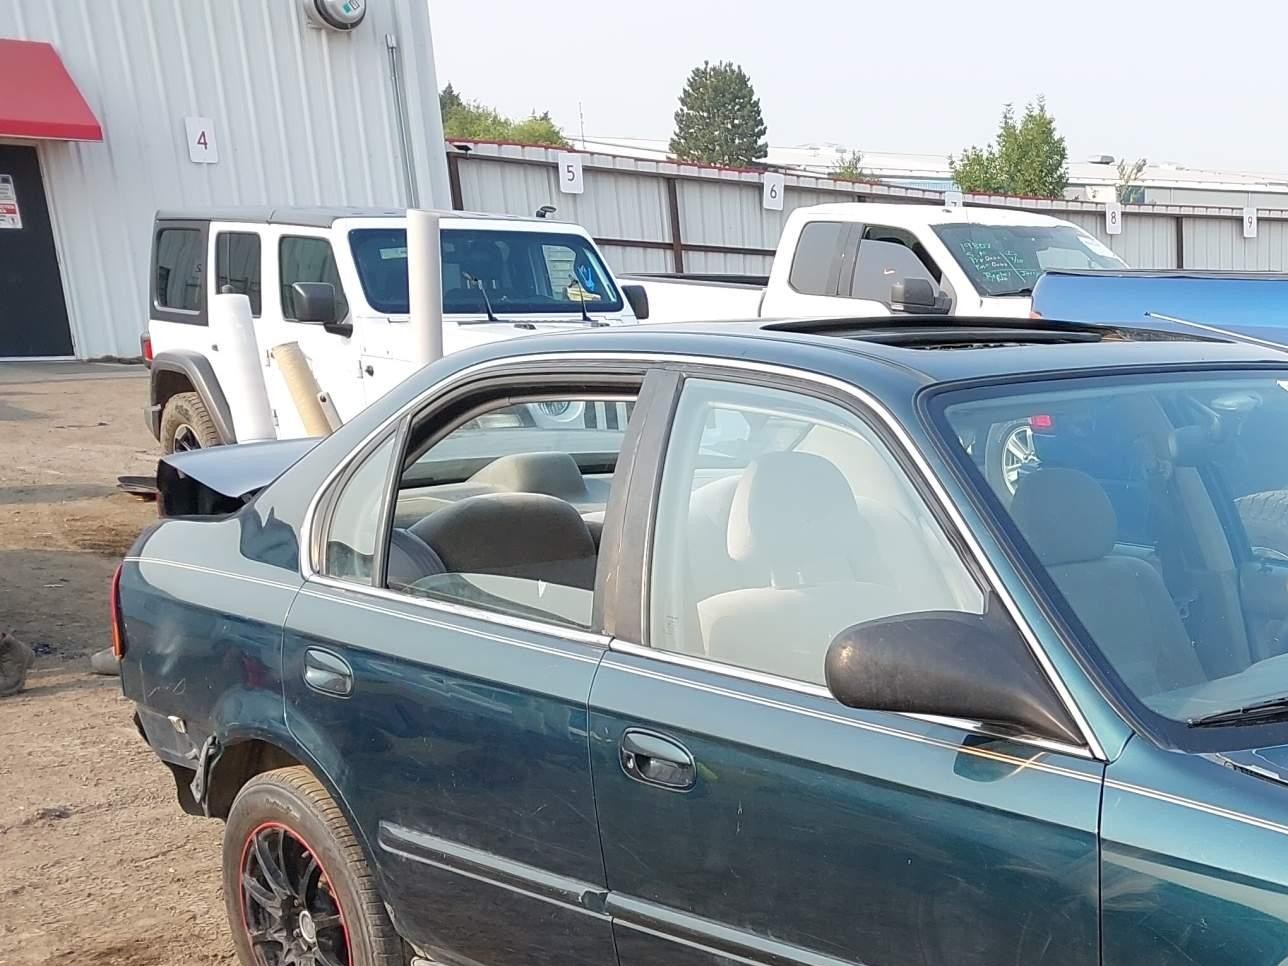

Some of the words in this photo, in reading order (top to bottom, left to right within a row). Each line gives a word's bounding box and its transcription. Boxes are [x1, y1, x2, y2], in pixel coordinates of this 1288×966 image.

[197, 130, 208, 151] 4
[566, 164, 576, 182] 5
[769, 183, 778, 199] 6
[1110, 211, 1117, 224] 8
[1246, 215, 1253, 228] 9
